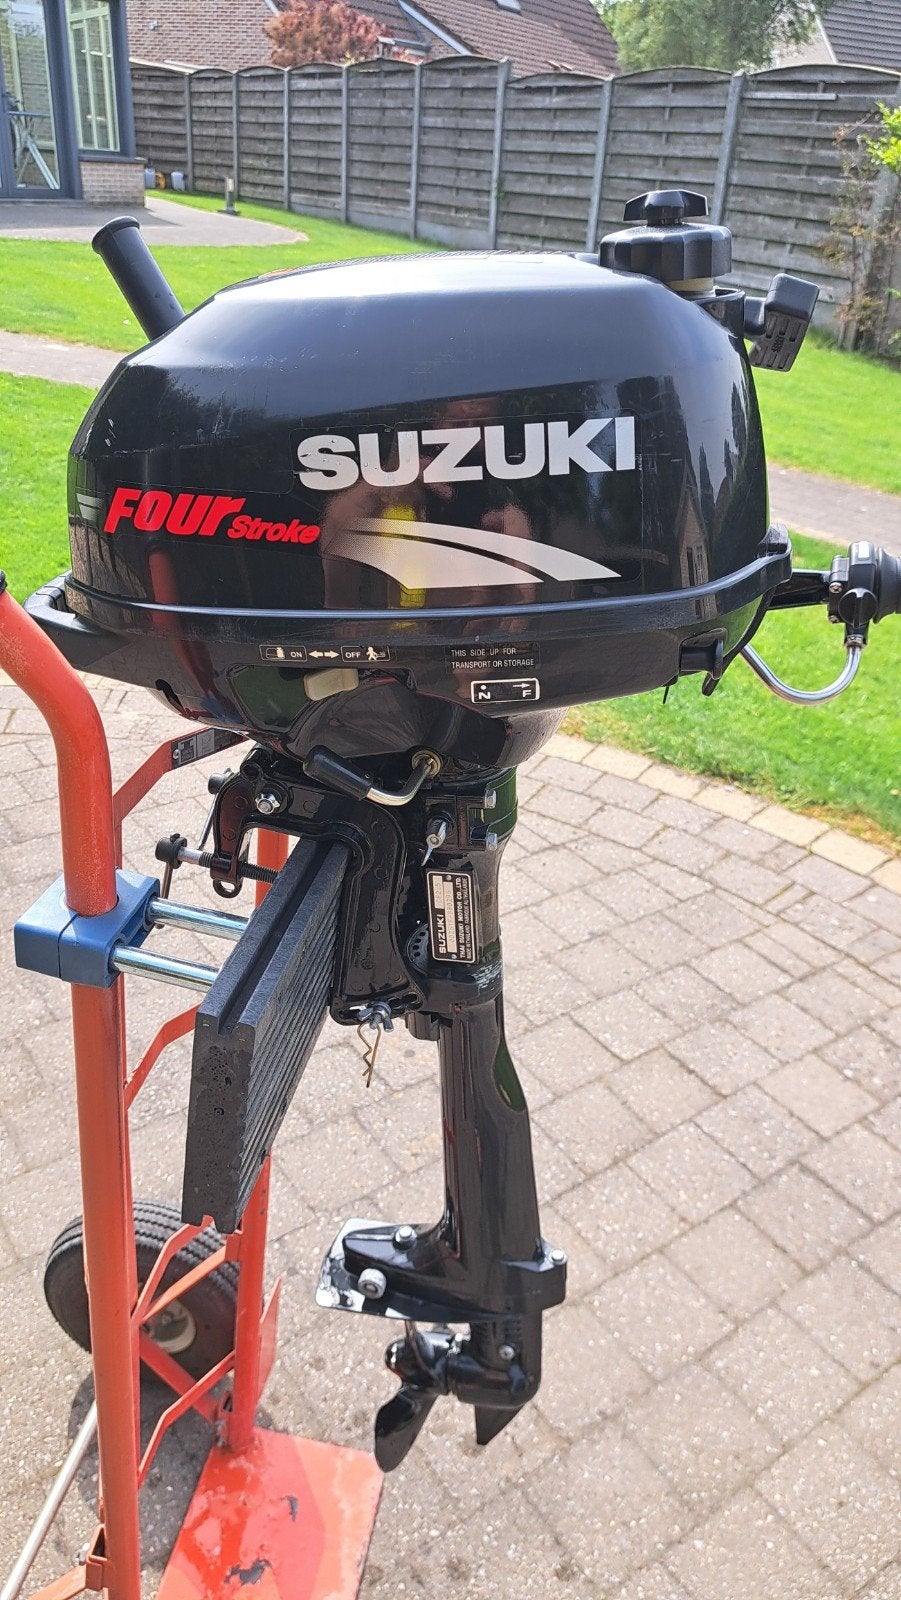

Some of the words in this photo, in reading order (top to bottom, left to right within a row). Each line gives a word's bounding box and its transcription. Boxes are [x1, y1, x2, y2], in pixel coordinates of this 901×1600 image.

[297, 416, 636, 491] SUZUKI
[227, 515, 320, 545] Stroke
[345, 651, 361, 659] OFF
[451, 649, 467, 657] THIS
[470, 648, 486, 657] SIDE
[489, 648, 500, 656] UP
[503, 647, 517, 655] FOR
[451, 660, 491, 669] TRANSPORT
[492, 660, 503, 668] OR
[504, 658, 535, 667] STORAGE
[478, 691, 491, 700] N
[522, 689, 532, 698] F
[437, 914, 447, 954] SUZUKI
